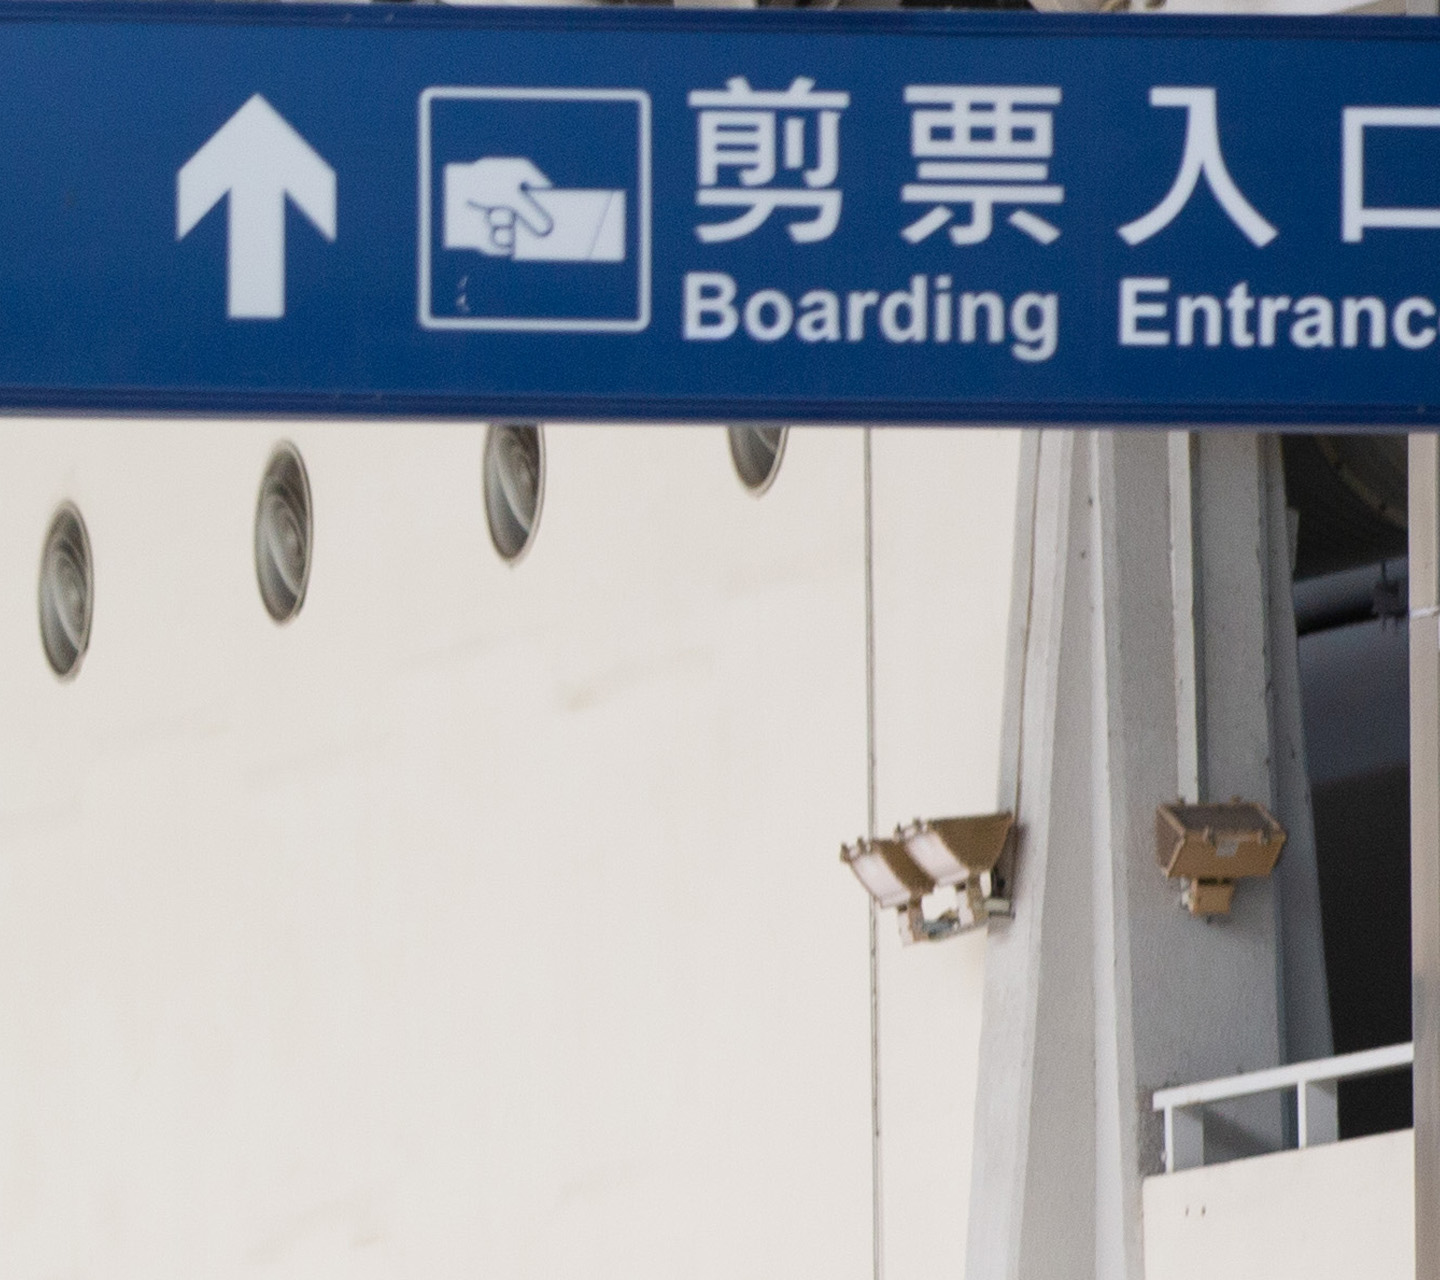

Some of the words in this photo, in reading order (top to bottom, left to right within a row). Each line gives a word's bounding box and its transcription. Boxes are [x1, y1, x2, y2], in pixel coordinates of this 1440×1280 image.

[687, 76, 1440, 247] 剪票入口
[682, 271, 1058, 362] Boarding
